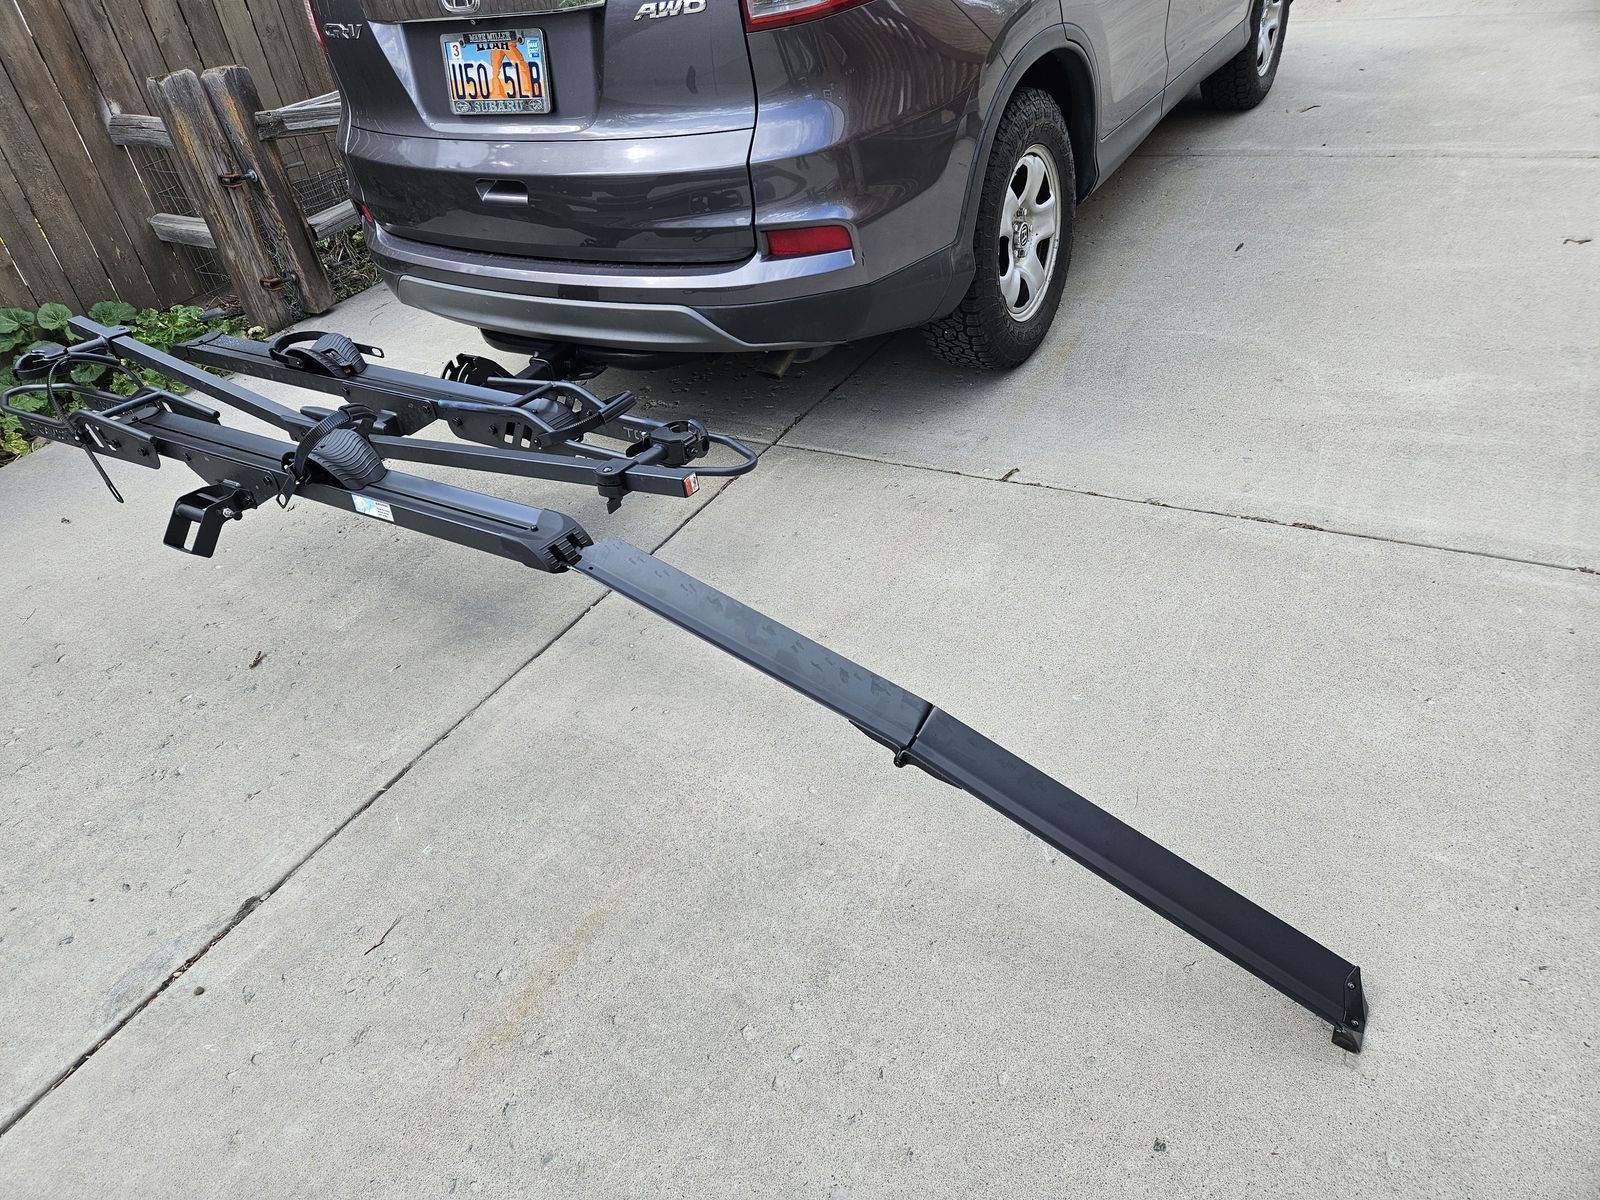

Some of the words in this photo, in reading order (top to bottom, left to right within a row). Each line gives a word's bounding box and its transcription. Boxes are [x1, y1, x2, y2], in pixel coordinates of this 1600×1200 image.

[633, 0, 706, 20] AWD
[487, 31, 511, 41] MILLER
[453, 44, 460, 57] 3
[475, 100, 523, 112] SUBARU
